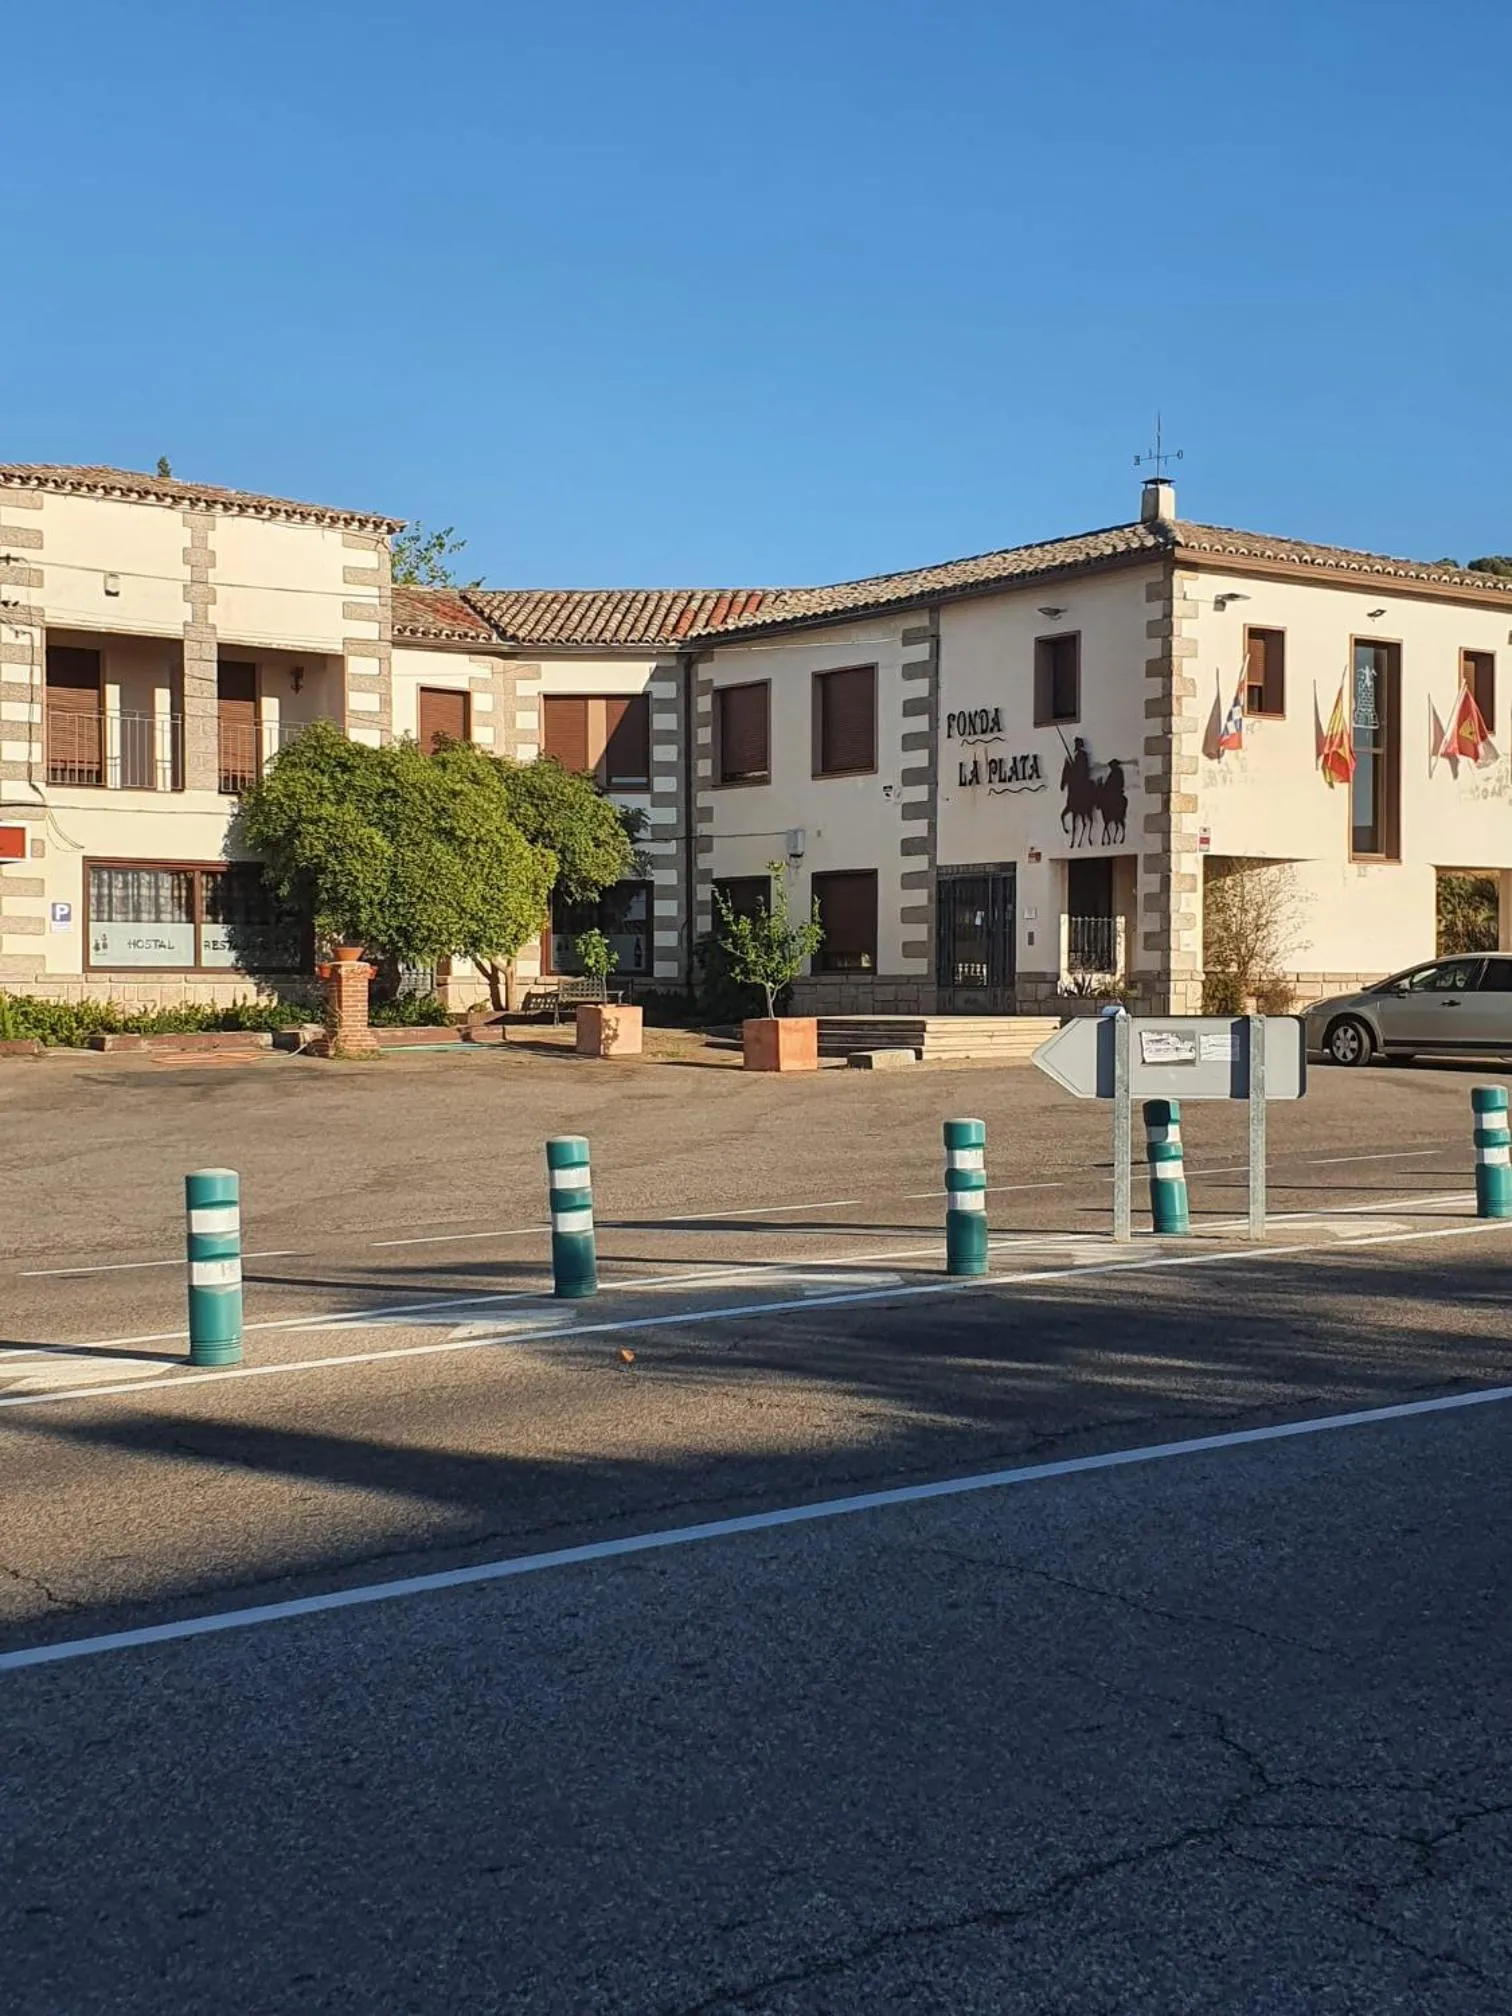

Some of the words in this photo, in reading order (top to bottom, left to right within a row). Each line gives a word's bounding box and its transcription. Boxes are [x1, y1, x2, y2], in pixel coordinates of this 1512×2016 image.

[946, 707, 1003, 739] FONDA
[958, 760, 981, 787] LA
[987, 753, 1043, 784] PLATA
[55, 904, 69, 921] P
[127, 938, 175, 950] HOSTAL
